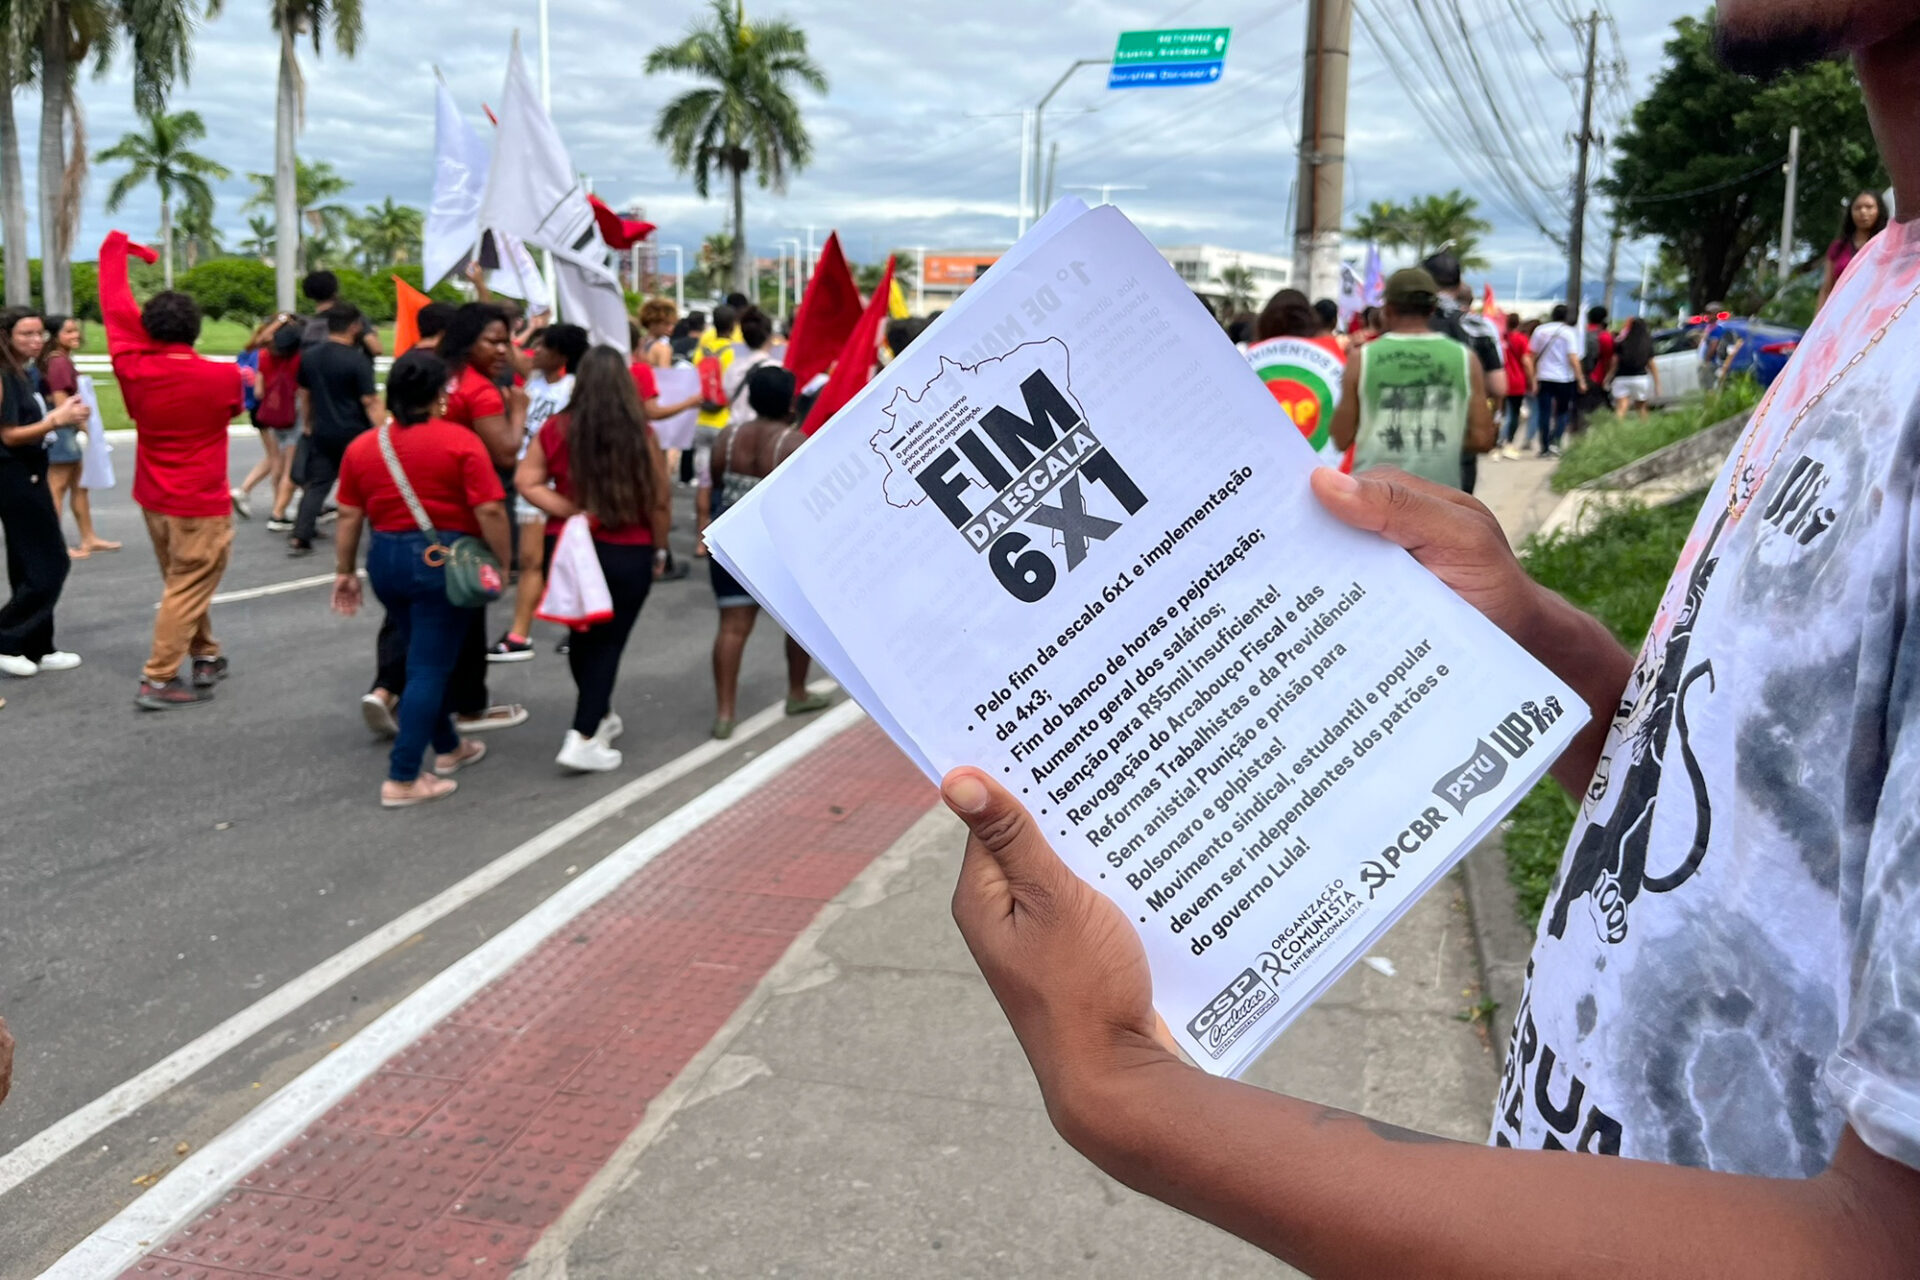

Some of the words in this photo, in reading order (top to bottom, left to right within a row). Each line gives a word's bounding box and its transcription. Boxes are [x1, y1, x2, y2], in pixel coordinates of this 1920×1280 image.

[914, 368, 1081, 530] FIM
[936, 410, 950, 423] tem
[948, 396, 967, 412] como
[965, 512, 1009, 548] DA
[1008, 429, 1097, 512] ESCALA
[973, 687, 1012, 722] Pelo
[1008, 662, 1039, 690] fim
[1036, 644, 1059, 666] da
[1056, 601, 1106, 647] escala
[1102, 571, 1134, 603] 6x1
[1132, 564, 1145, 577] e
[1139, 466, 1253, 568] implementação
[1009, 732, 1045, 763] Fim
[1042, 714, 1063, 736] do
[1057, 672, 1107, 718] banco
[1106, 654, 1127, 675] de
[1121, 616, 1168, 658] horas
[1166, 606, 1179, 619] e
[1176, 528, 1266, 612] pejotização;
[995, 720, 1018, 742] da
[1015, 688, 1053, 722] 4x3;
[1030, 719, 1099, 785] Aumento
[1097, 678, 1138, 724] geral
[1135, 657, 1165, 686] dos
[1162, 602, 1226, 661] salários;
[1047, 748, 1109, 806] Isenção
[1106, 716, 1144, 755] para
[1136, 664, 1194, 720] R$5mil
[1187, 583, 1281, 673] insuficiente!
[1065, 749, 1150, 827] Revogação
[1148, 730, 1170, 751] do
[1166, 660, 1245, 734] Arcabouço
[1239, 615, 1288, 663] Fiscal
[1285, 610, 1298, 623] e
[1295, 585, 1325, 613] das
[1085, 777, 1162, 848] Reformas
[1154, 694, 1250, 779] Trabalhistas
[1248, 684, 1261, 697] e
[1259, 665, 1281, 687] da
[1274, 581, 1366, 669] Previdência!
[1488, 711, 1535, 759] UP
[1106, 833, 1146, 868] Sem
[1143, 777, 1201, 837] anistia!
[1193, 728, 1257, 785] Punição
[1255, 717, 1269, 730] e
[1265, 674, 1313, 723] prisão
[1310, 643, 1347, 681] para
[1125, 818, 1204, 891] Bolsonaro
[1202, 807, 1216, 820] e
[1213, 735, 1287, 813] golpistas!
[1145, 830, 1234, 913] Movimento
[1231, 772, 1296, 833] sindical,
[1292, 697, 1368, 775] estudantil
[1365, 692, 1379, 704] e
[1375, 638, 1432, 698] popular
[1170, 882, 1224, 934] devem
[1220, 856, 1247, 885] ser
[1241, 755, 1355, 862] independentes
[1352, 729, 1383, 758] dos
[1379, 675, 1438, 735] patrões
[1436, 664, 1449, 677] e
[1446, 753, 1496, 801] PSTU
[1190, 934, 1213, 956] do
[1211, 875, 1274, 940] governo
[1266, 835, 1311, 878] Lula!
[1380, 806, 1449, 869] PCBR
[1271, 879, 1343, 950] ORGANIZAÇÃO
[1280, 890, 1356, 961] COMUNISTA
[1290, 900, 1364, 971] INTERNACIONALISTA
[1194, 974, 1252, 1032] CSP
[1208, 987, 1266, 1048] Conlutas
